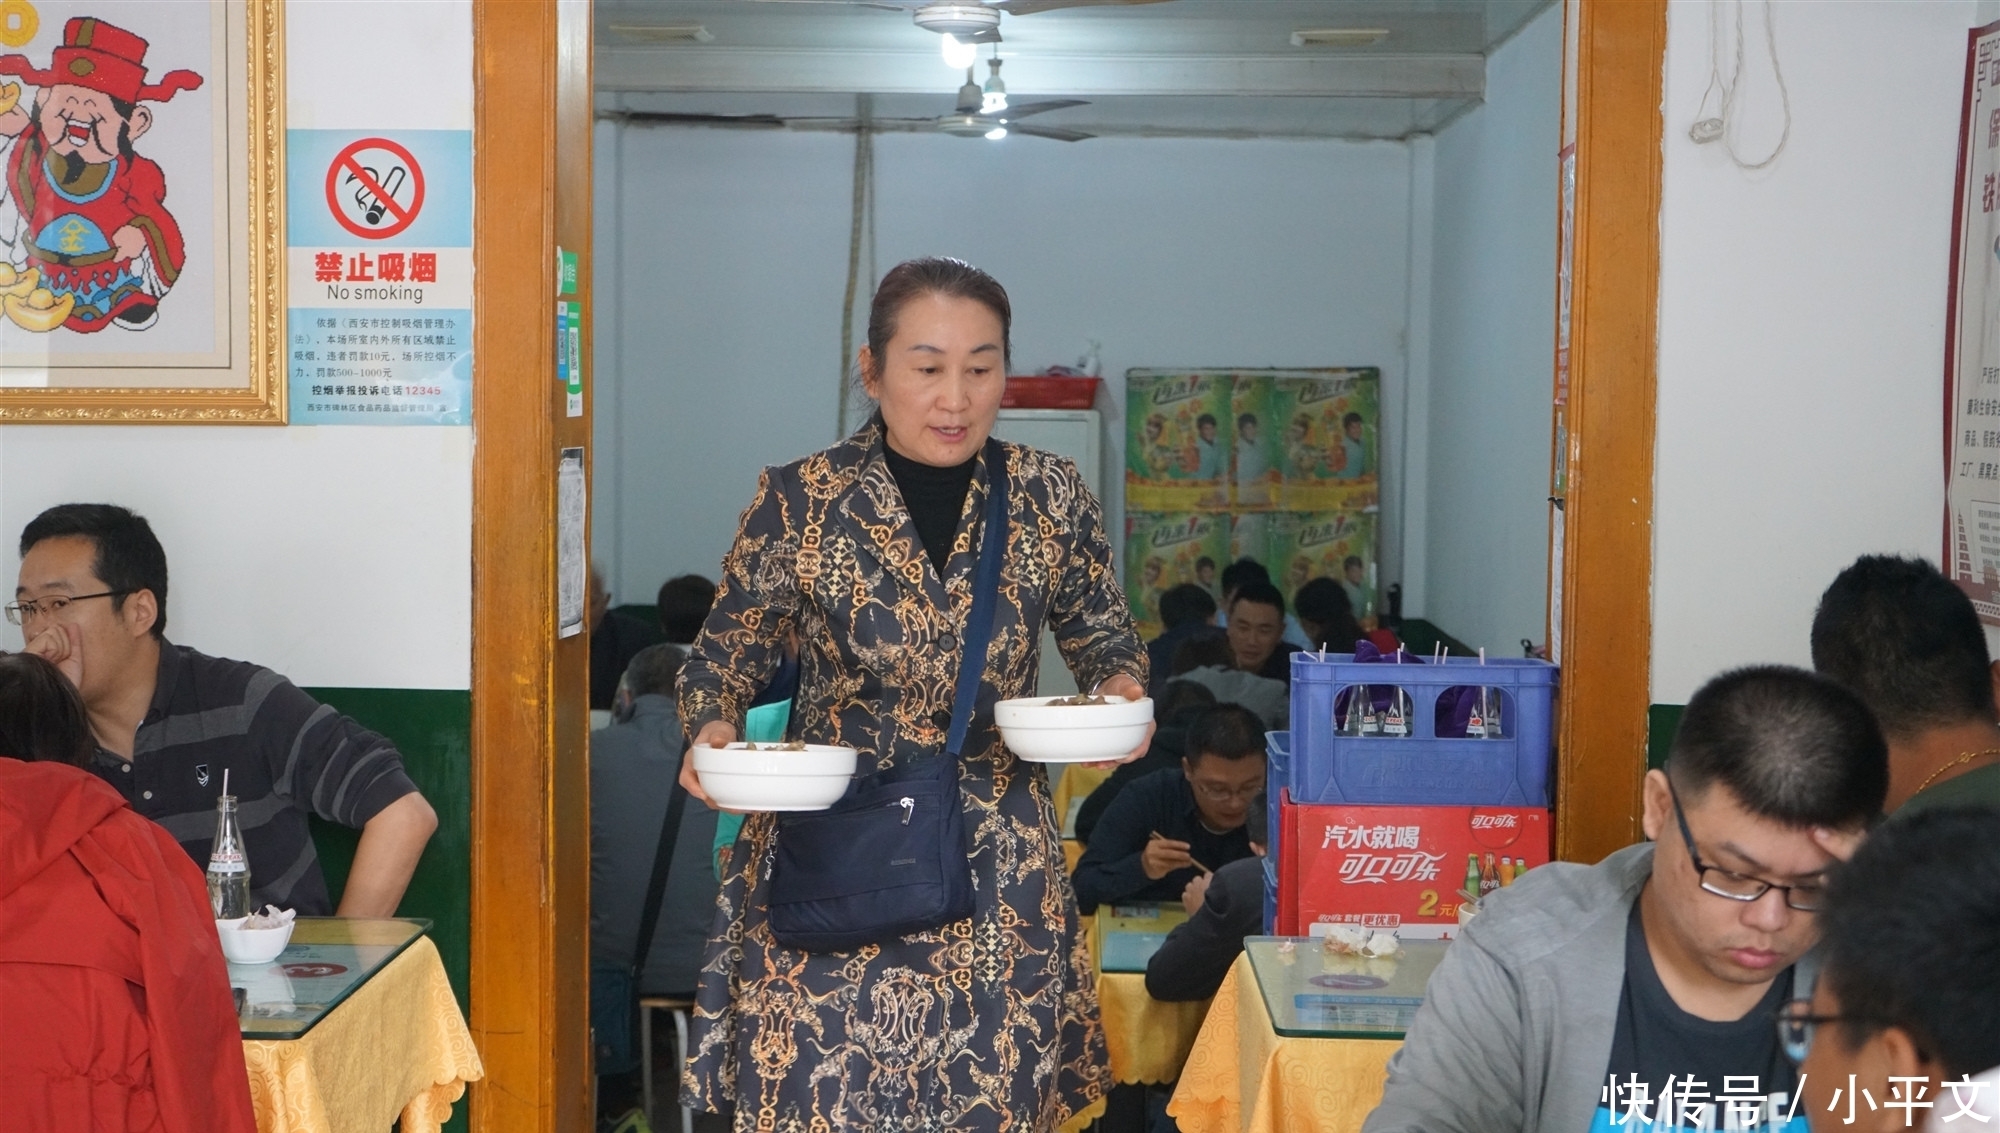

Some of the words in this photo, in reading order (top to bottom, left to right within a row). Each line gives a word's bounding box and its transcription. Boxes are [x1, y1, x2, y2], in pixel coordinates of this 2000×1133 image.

[315, 252, 437, 282] 禁止吸烟
[327, 284, 349, 300] No
[354, 284, 423, 304] smoking
[312, 385, 402, 396] 控烟举报投诉电话
[406, 386, 441, 395] 12345
[1472, 814, 1519, 829] 可口可乐
[1322, 825, 1420, 849] 汽水就喝
[1339, 852, 1447, 884] 可口可乐
[1418, 889, 1439, 916] 2
[1440, 903, 1459, 917] 元/
[1364, 915, 1398, 926] 更优惠
